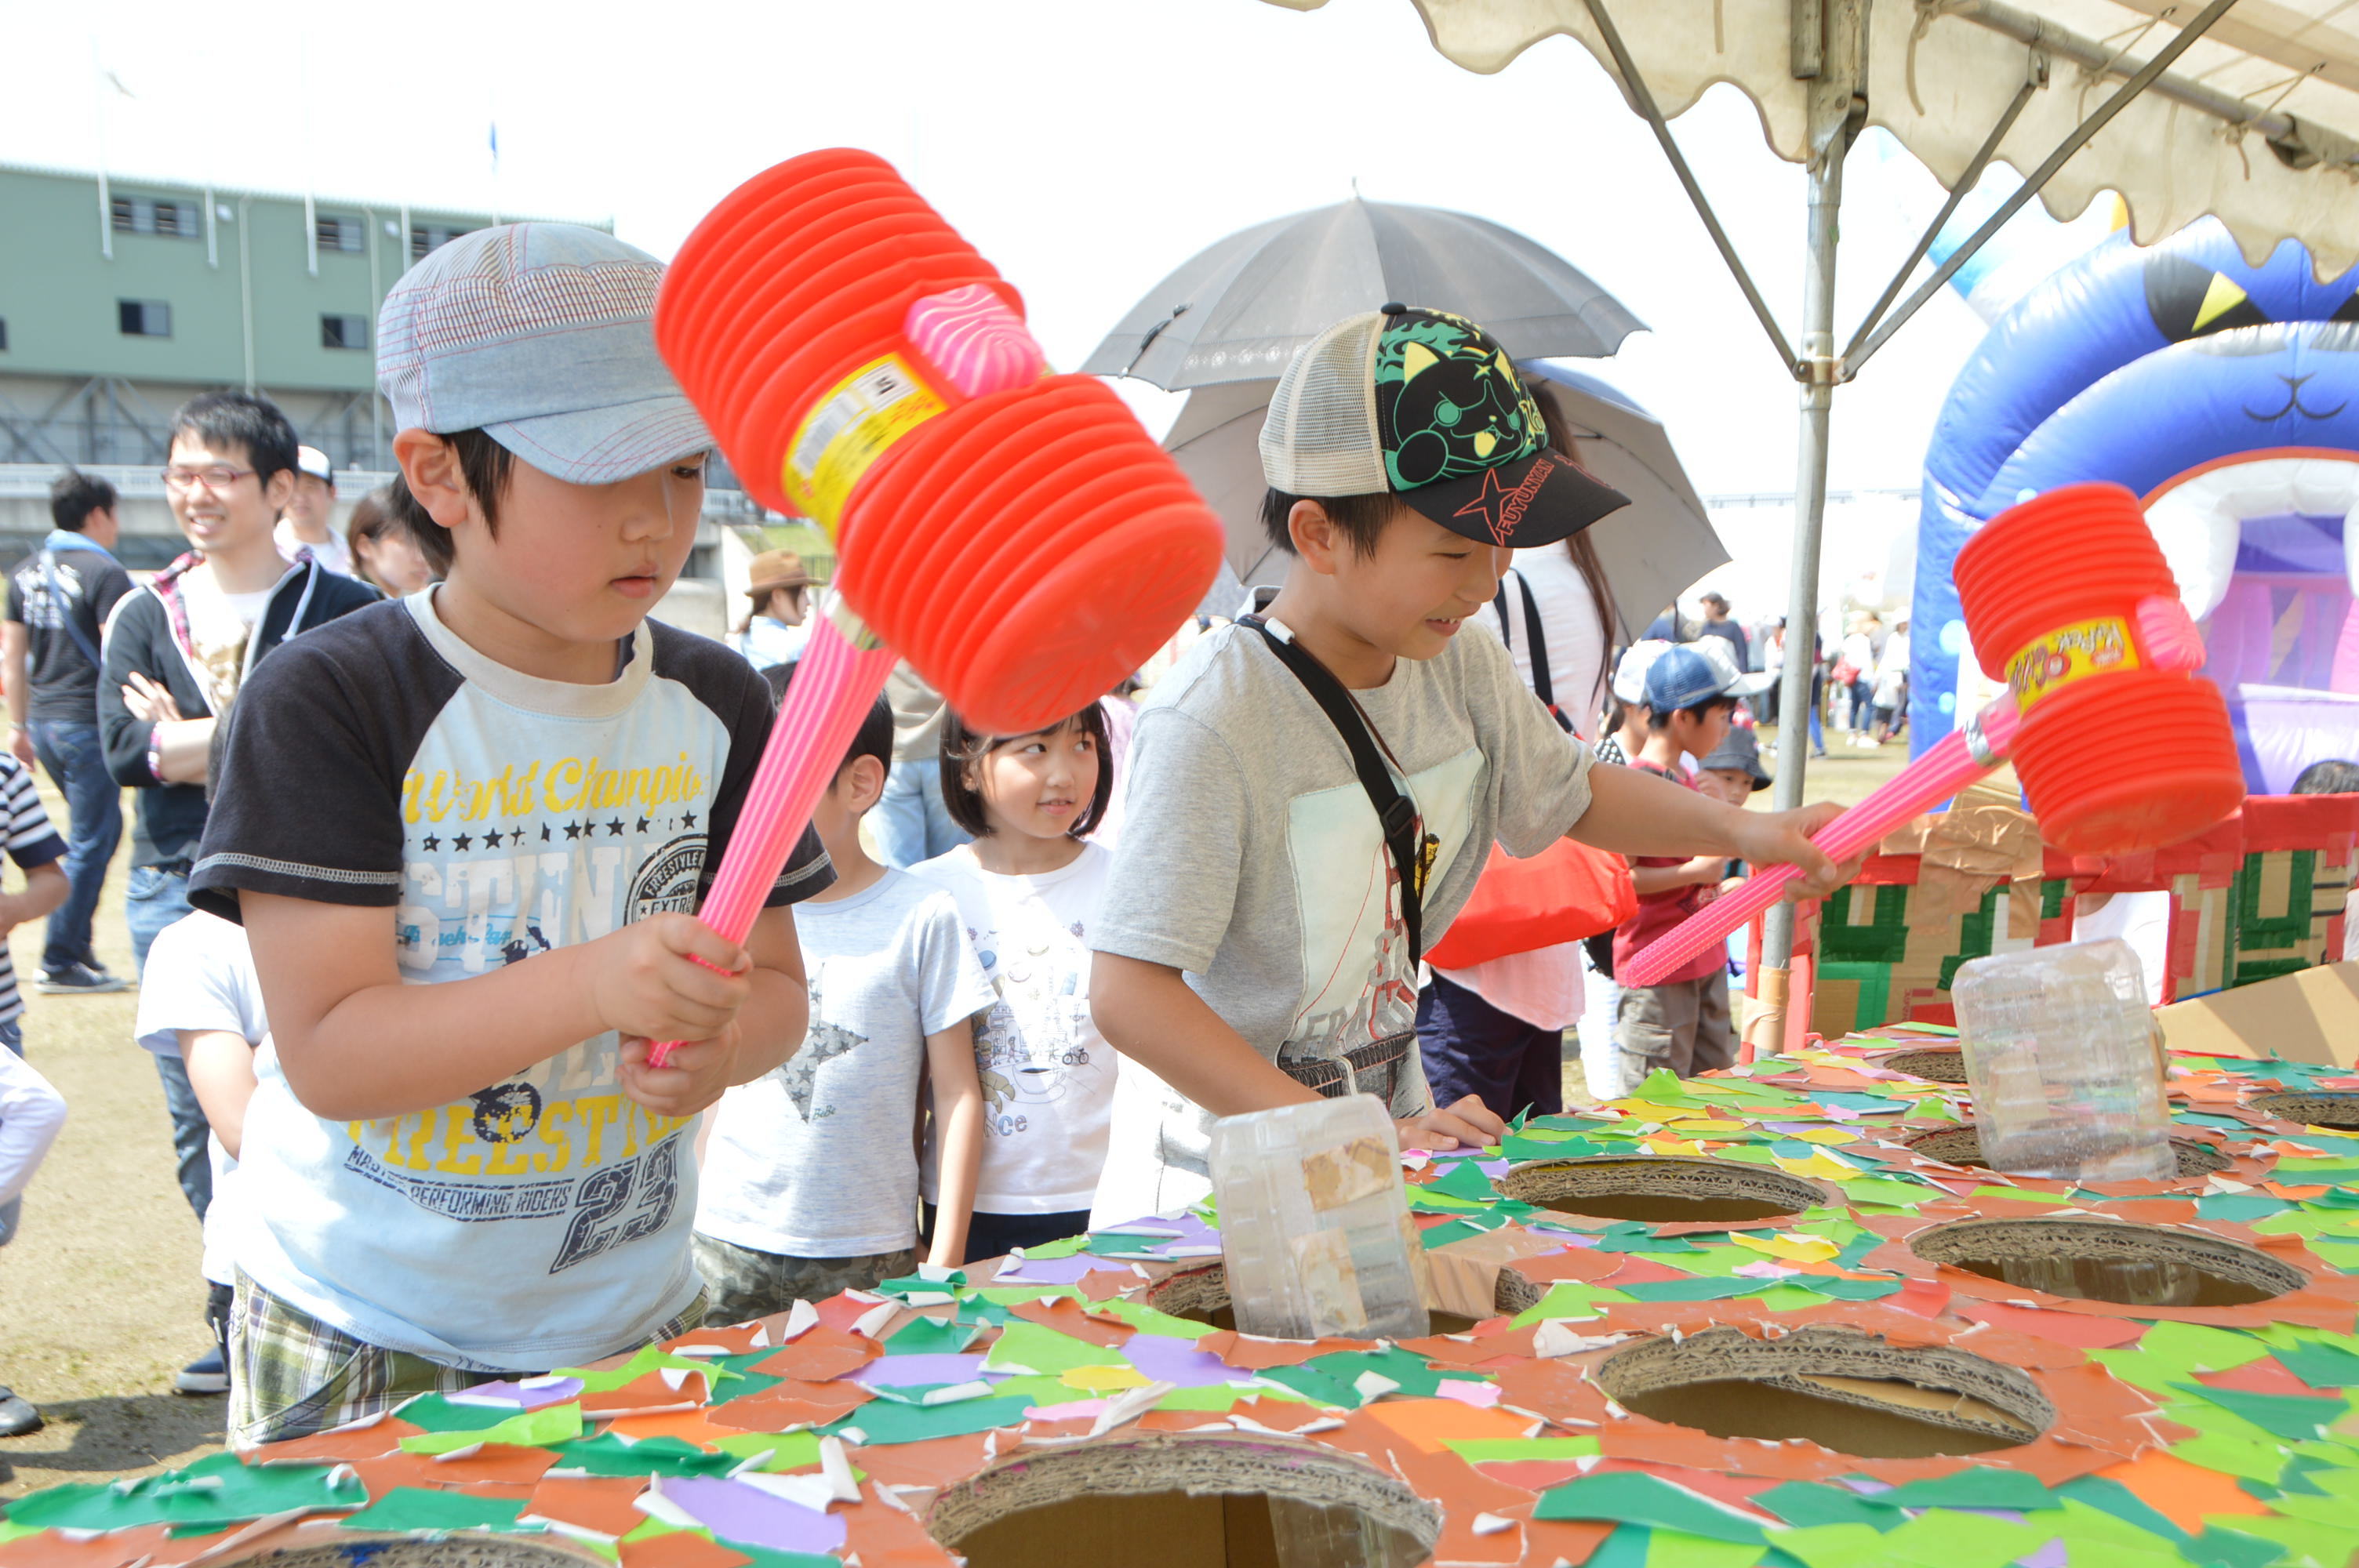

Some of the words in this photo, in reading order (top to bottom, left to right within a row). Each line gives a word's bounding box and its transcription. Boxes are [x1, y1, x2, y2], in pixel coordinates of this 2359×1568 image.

[1496, 458, 1555, 536] FUYUNYAN
[402, 759, 541, 825] World
[410, 1185, 514, 1215] PERFORMING
[514, 1185, 572, 1214] RIDERS
[549, 1130, 682, 1275] 23
